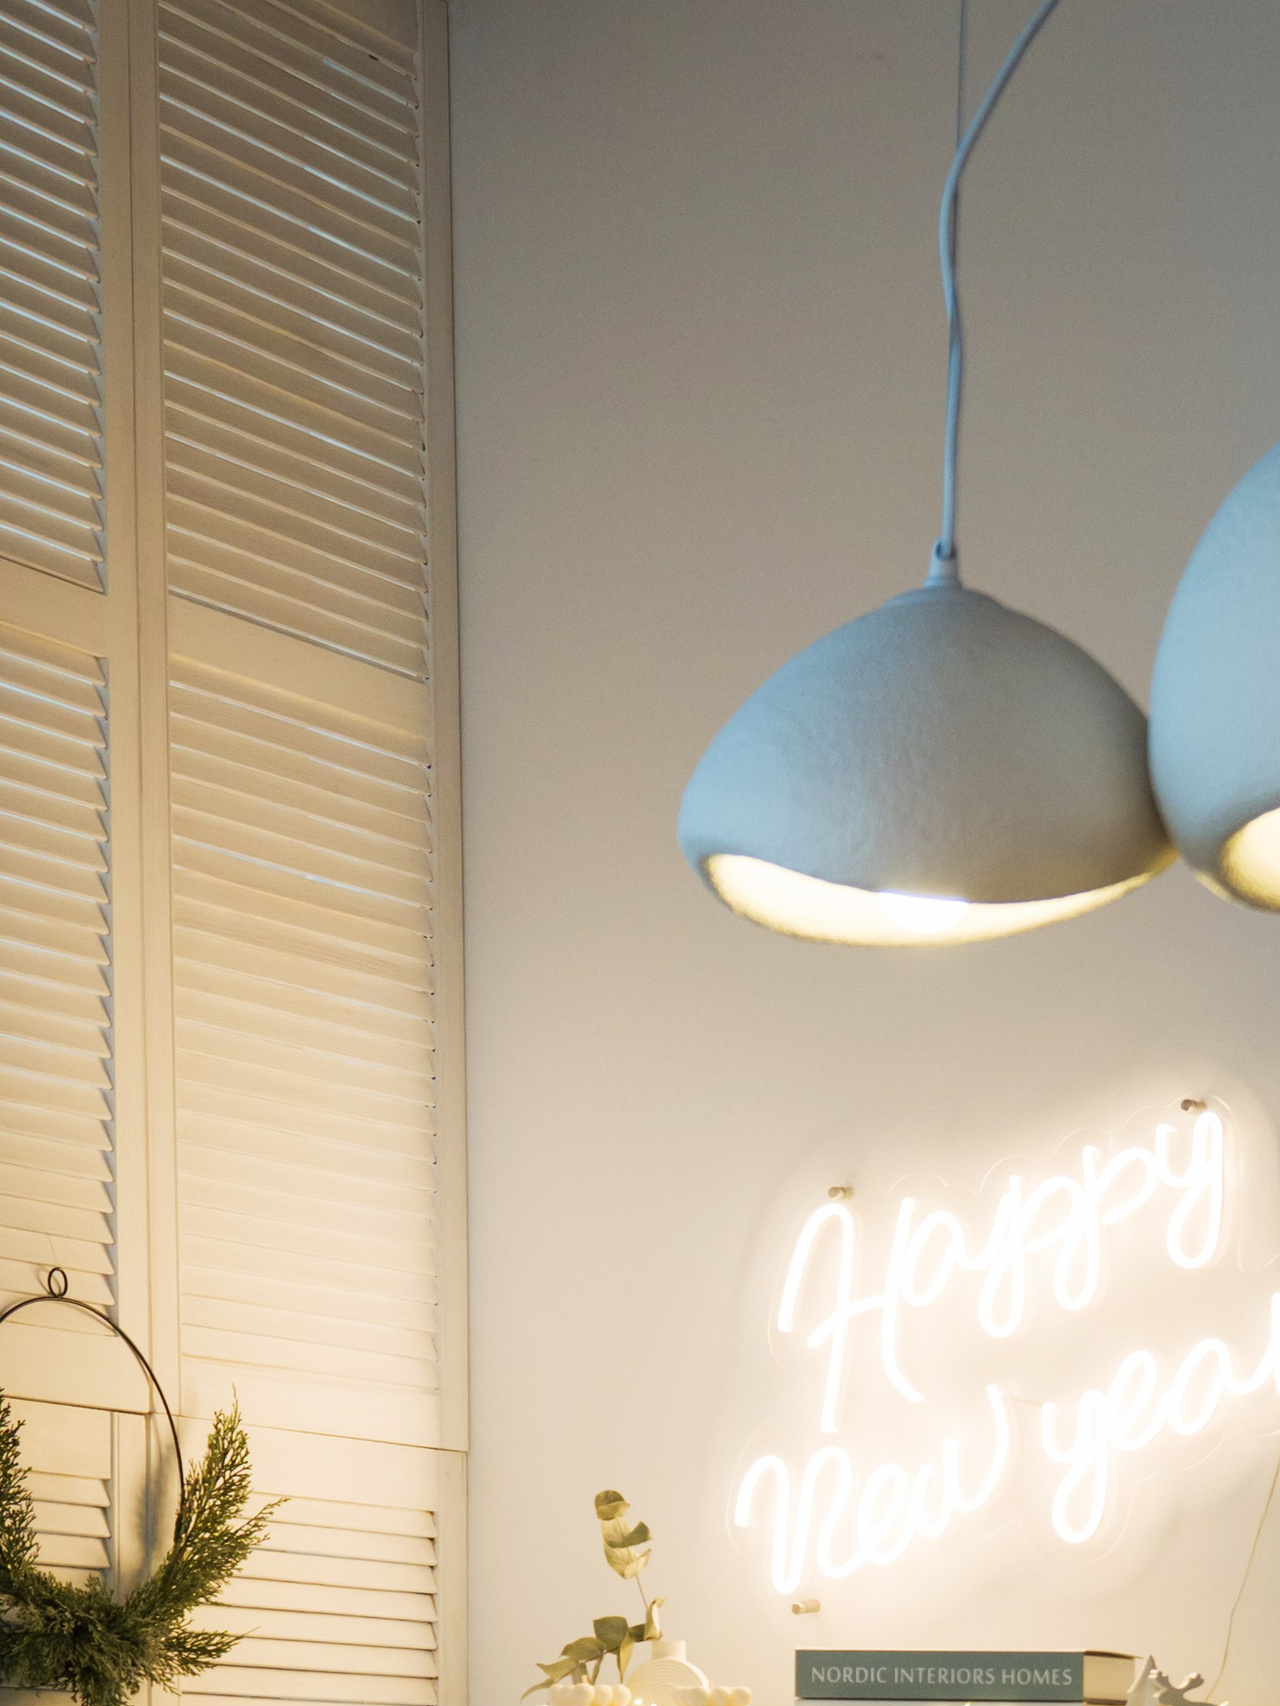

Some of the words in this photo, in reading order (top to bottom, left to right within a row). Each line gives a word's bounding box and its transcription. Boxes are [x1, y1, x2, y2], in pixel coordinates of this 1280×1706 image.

[777, 1111, 1223, 1434] Happy
[734, 1384, 1010, 1594] New
[811, 1666, 887, 1684] NORDIC
[894, 1667, 995, 1685] INTERIORS
[1001, 1668, 1072, 1686] HOMES
